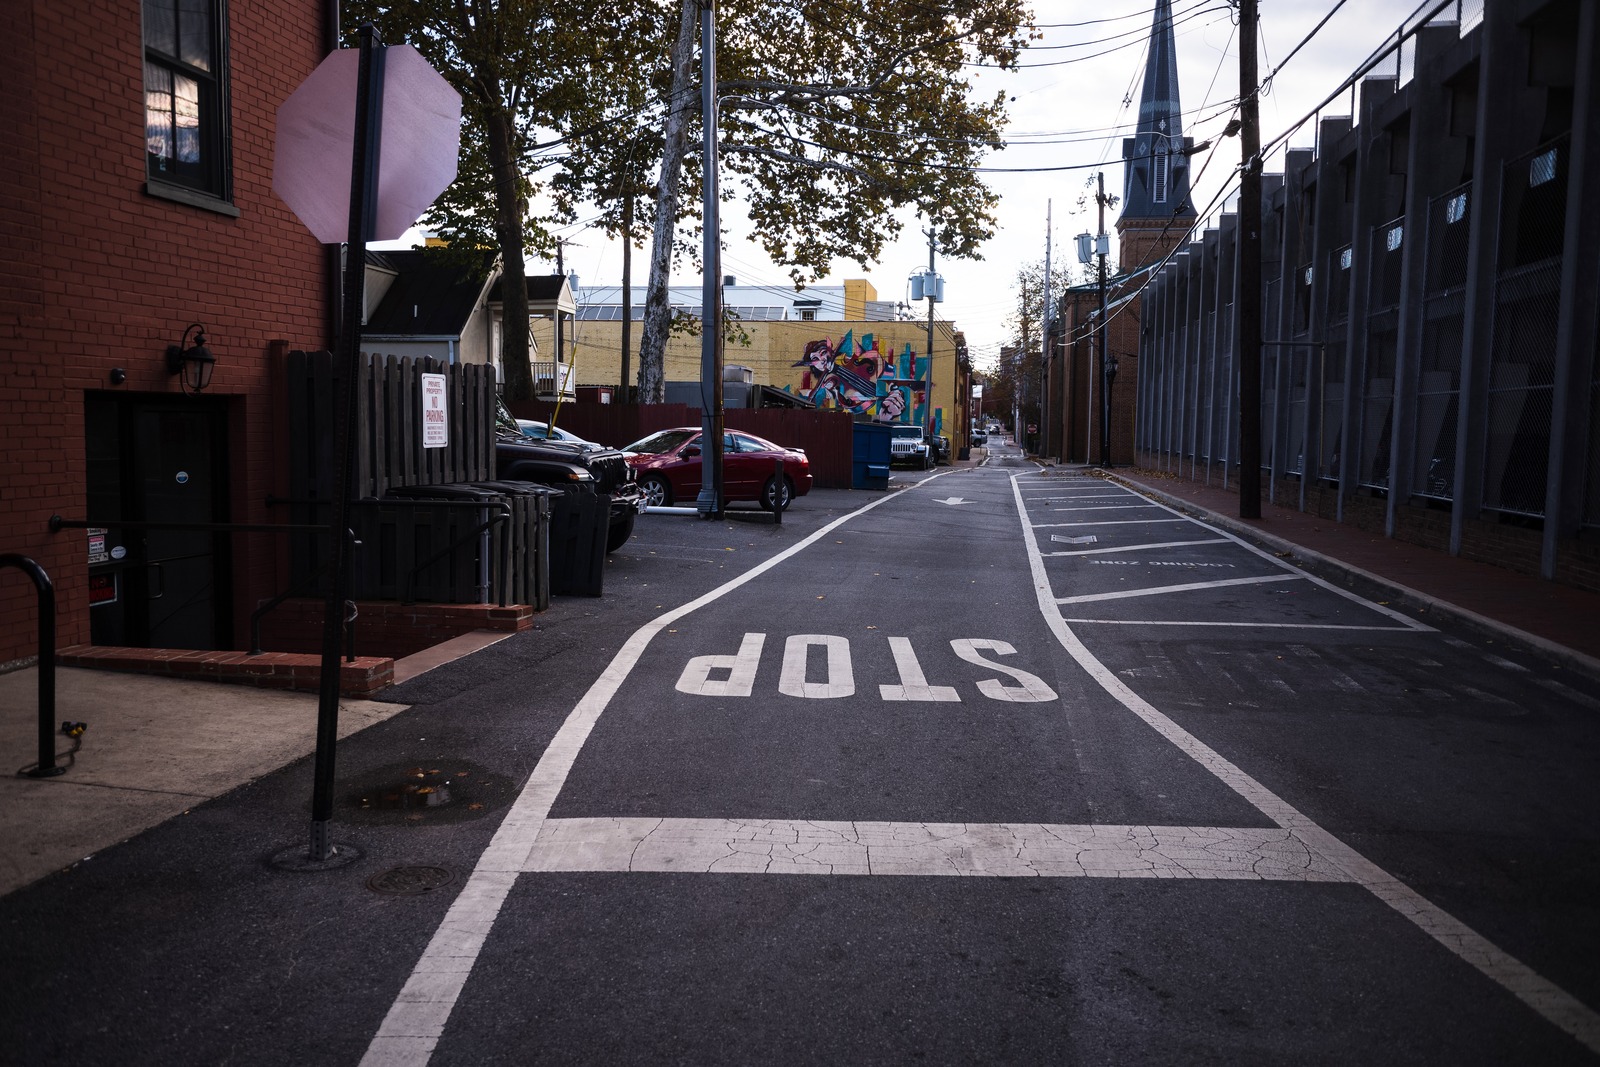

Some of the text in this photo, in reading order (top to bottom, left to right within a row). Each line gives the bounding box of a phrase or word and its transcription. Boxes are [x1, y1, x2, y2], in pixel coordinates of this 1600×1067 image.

[432, 396, 438, 408] NO
[426, 409, 444, 422] PARKING
[675, 633, 1059, 703] STOP
